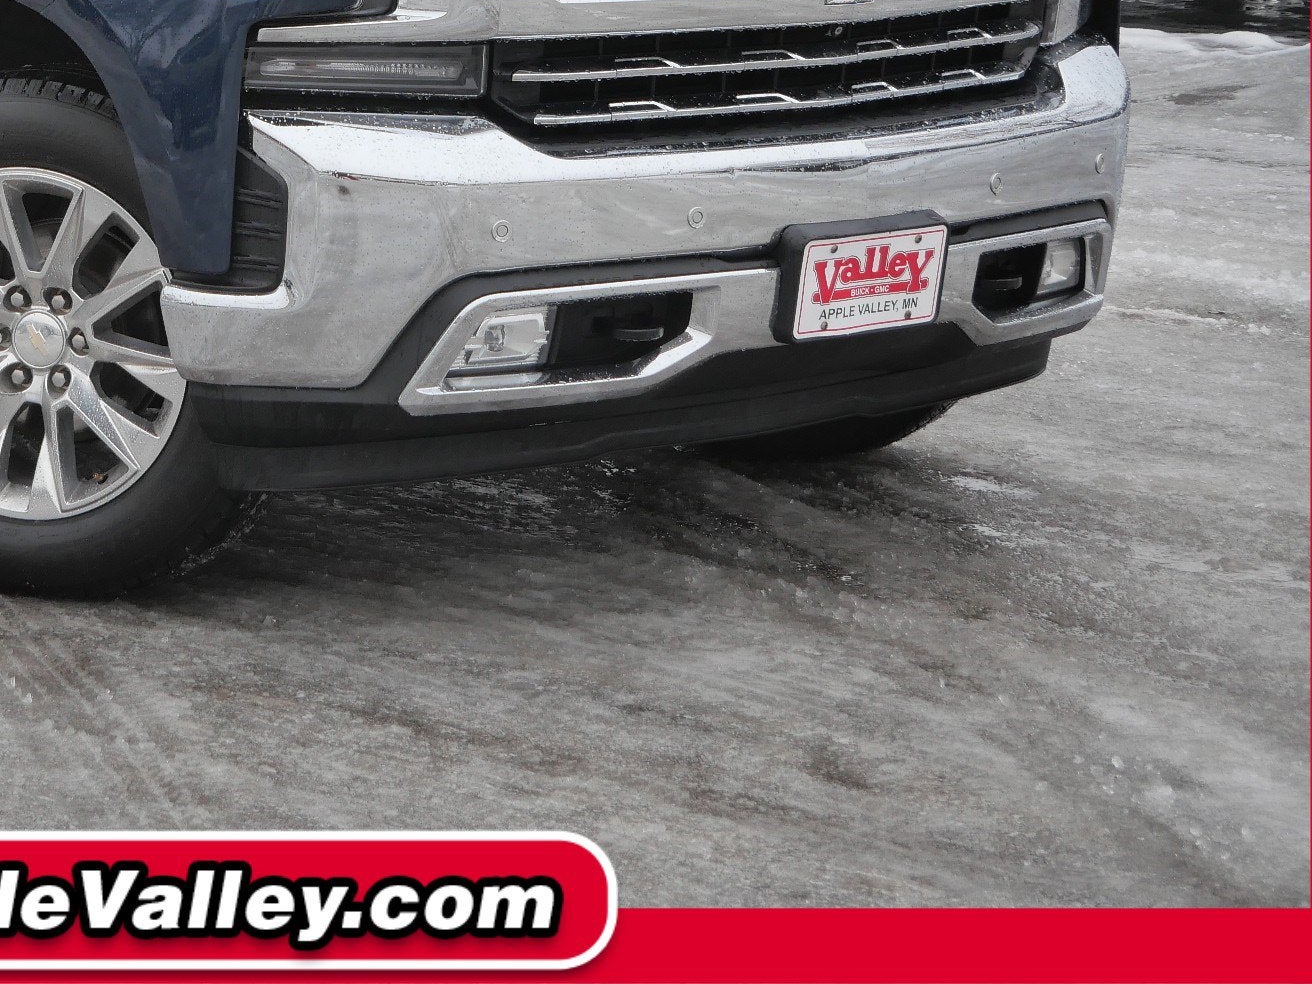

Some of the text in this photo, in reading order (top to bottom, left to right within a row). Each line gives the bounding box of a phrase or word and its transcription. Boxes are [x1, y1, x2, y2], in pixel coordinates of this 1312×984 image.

[850, 284, 890, 297] BUICK GMC
[818, 297, 919, 321] APPLE VALLEY, MN
